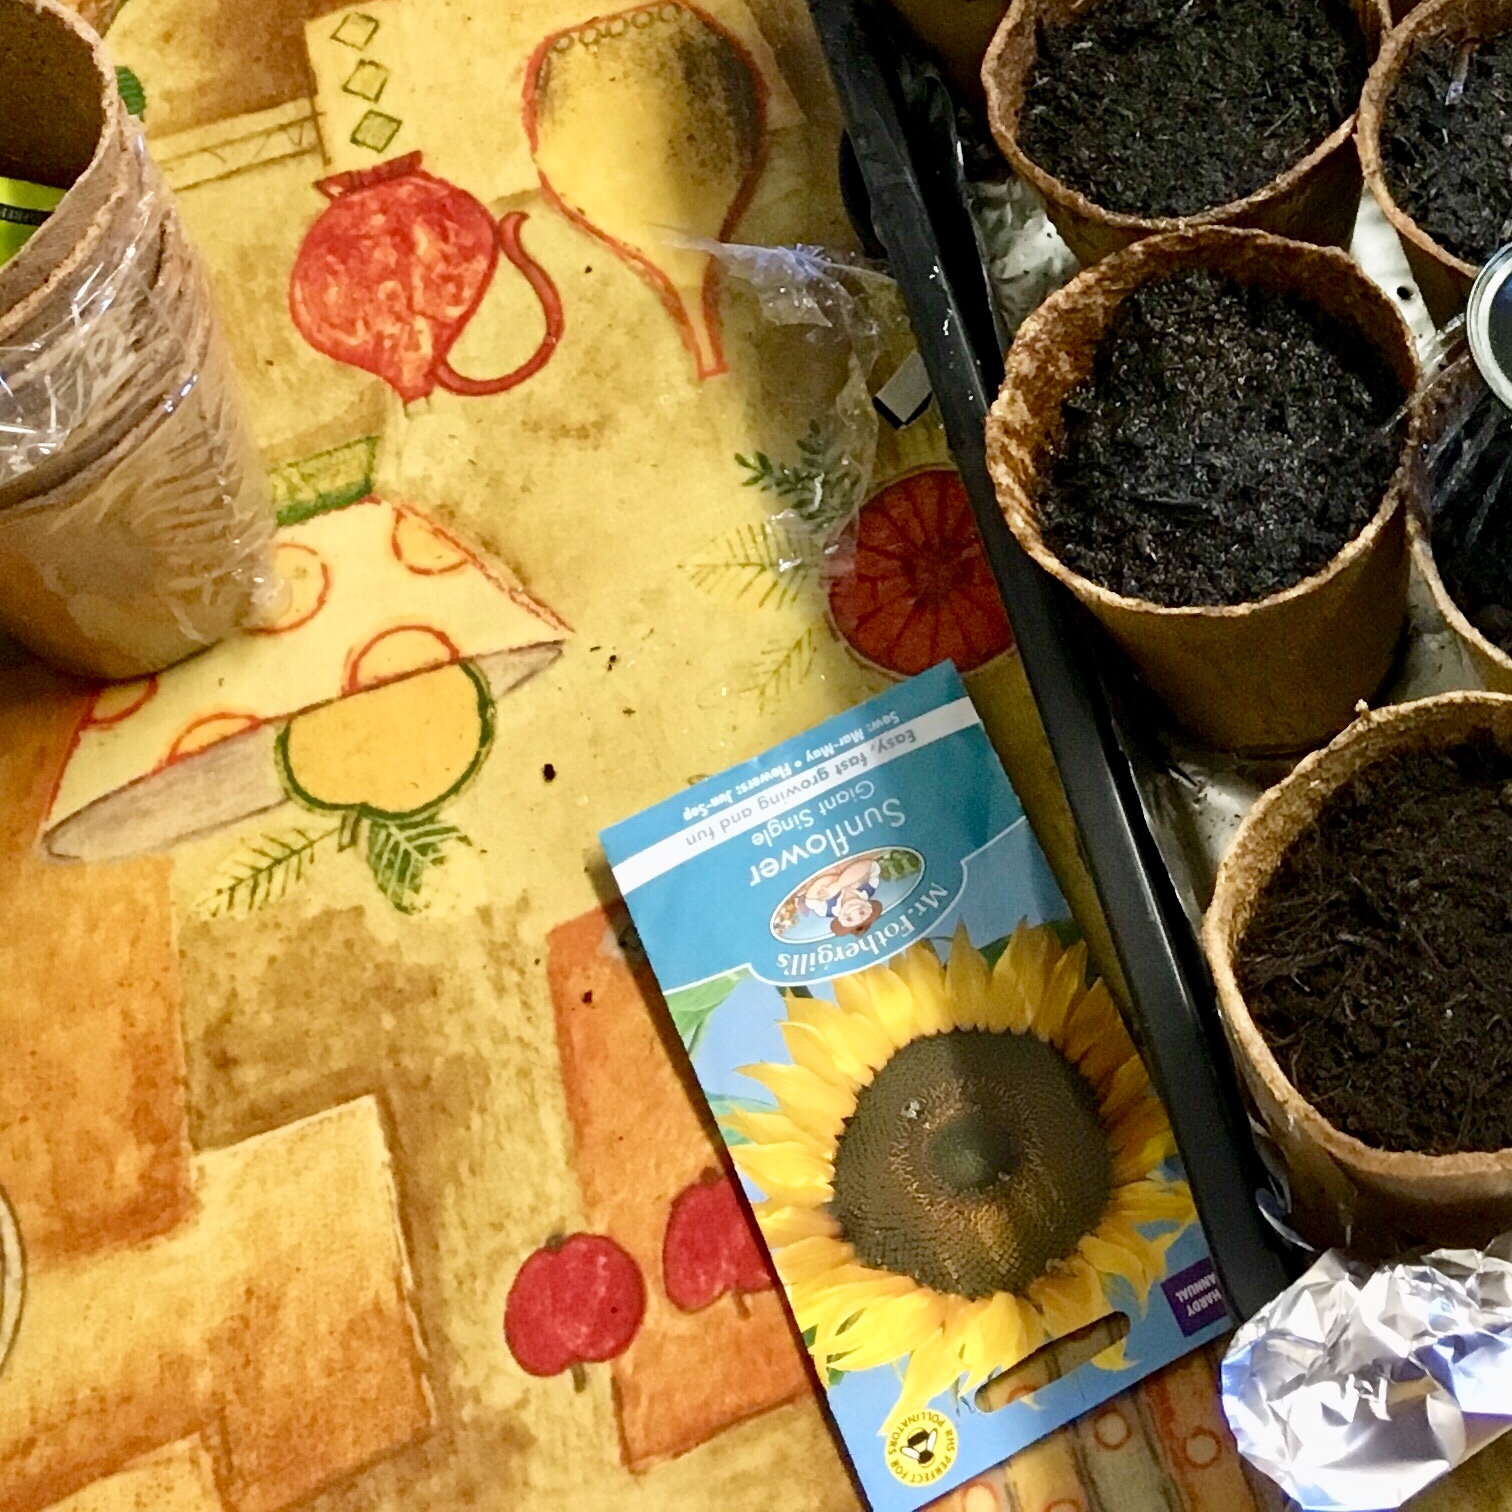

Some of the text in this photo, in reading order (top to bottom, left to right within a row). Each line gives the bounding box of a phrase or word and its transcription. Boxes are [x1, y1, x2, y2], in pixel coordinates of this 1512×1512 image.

[683, 711, 899, 820] Sow: Mar-May Flowers: Jun-Sep
[685, 729, 916, 847] Easy, fast growing and fun
[748, 798, 905, 887] Sunflower
[751, 780, 875, 848] Giant Single
[776, 883, 948, 975] Mr. Fothergill's
[1175, 1273, 1216, 1303] ANNUAL
[1186, 1288, 1222, 1317] HARDY
[888, 1412, 946, 1455] POLLINATORS
[890, 1429, 955, 1483] RHS PERFECT FOR
